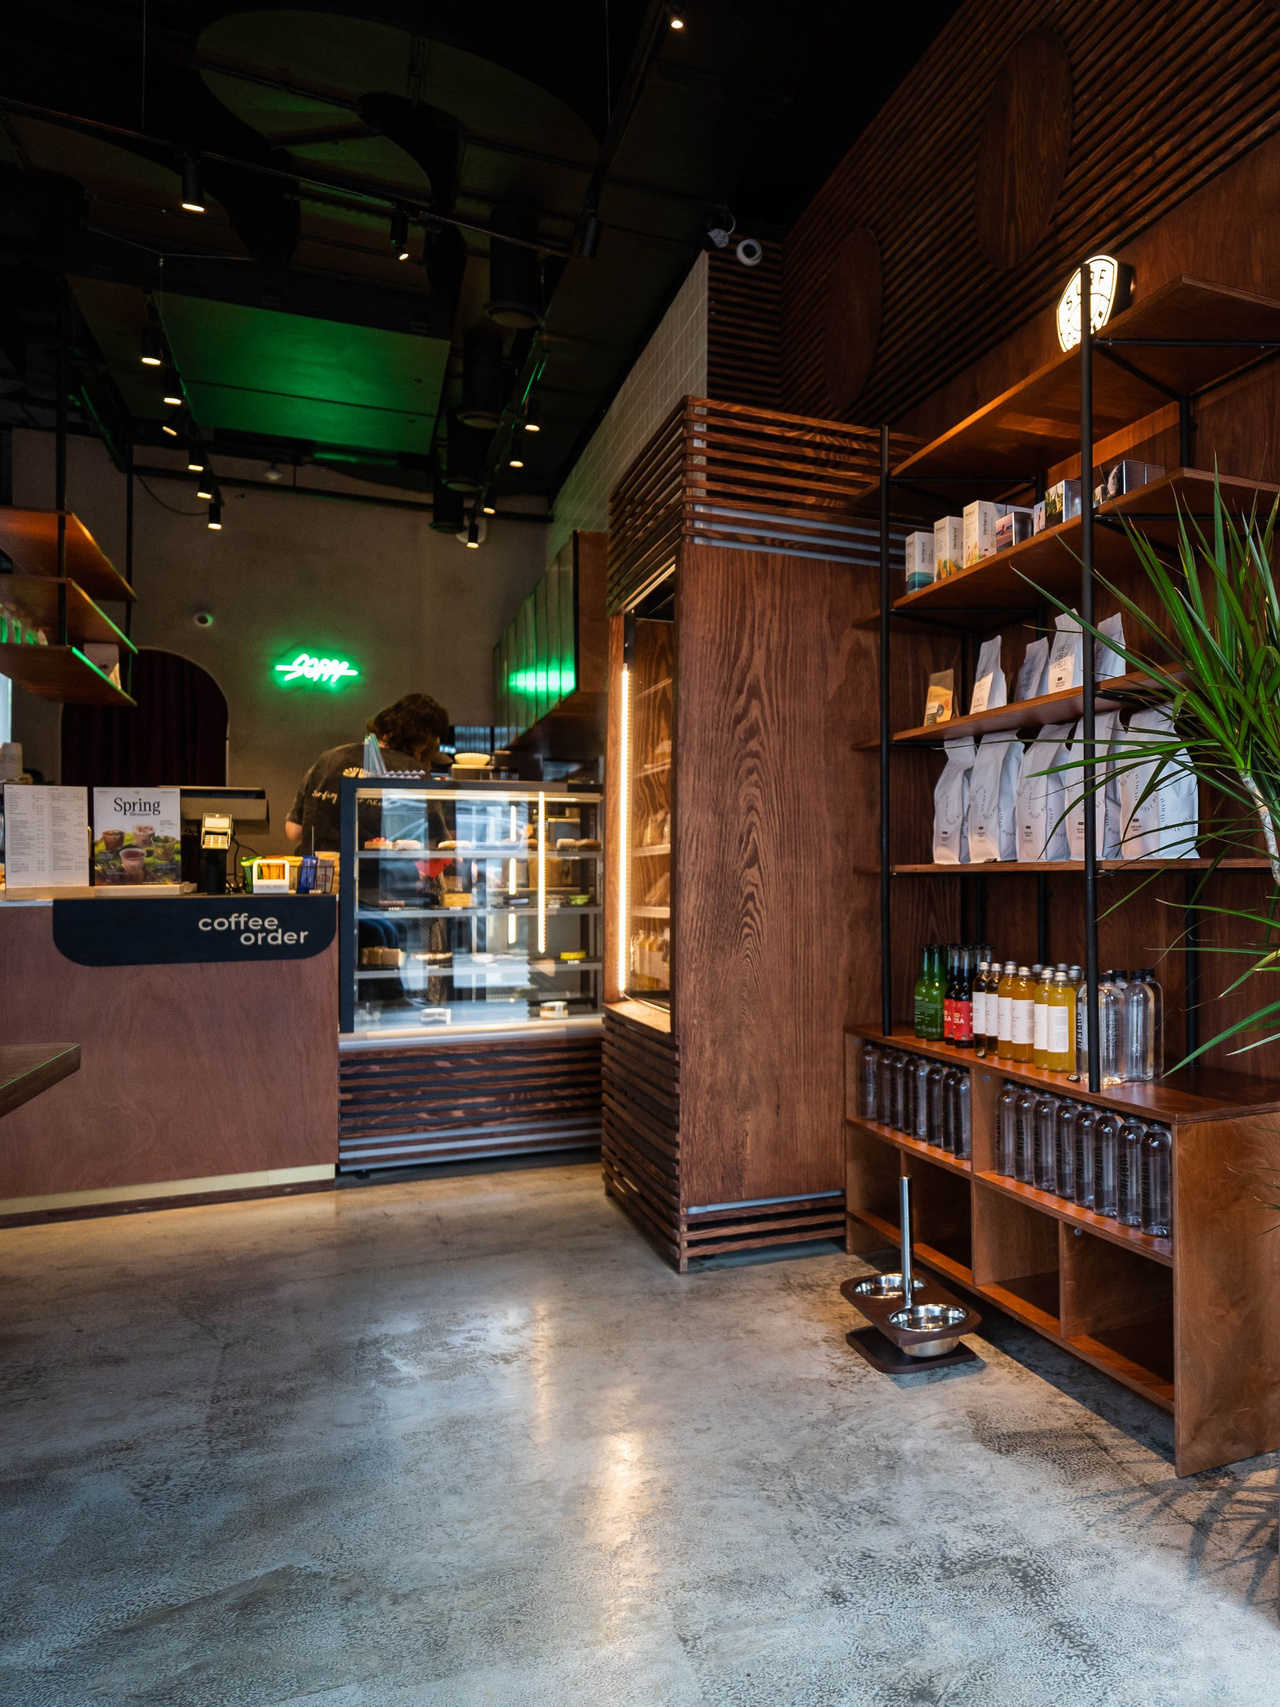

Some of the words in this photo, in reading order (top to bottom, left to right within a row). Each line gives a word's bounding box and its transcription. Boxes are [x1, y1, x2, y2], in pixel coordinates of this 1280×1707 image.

[113, 797, 162, 816] Spring
[198, 913, 279, 931] coffee
[240, 928, 309, 945] order
[1094, 1145, 1104, 1188] SURFING
[1119, 1153, 1129, 1197] SURFING
[1141, 1160, 1150, 1206] SURFING
